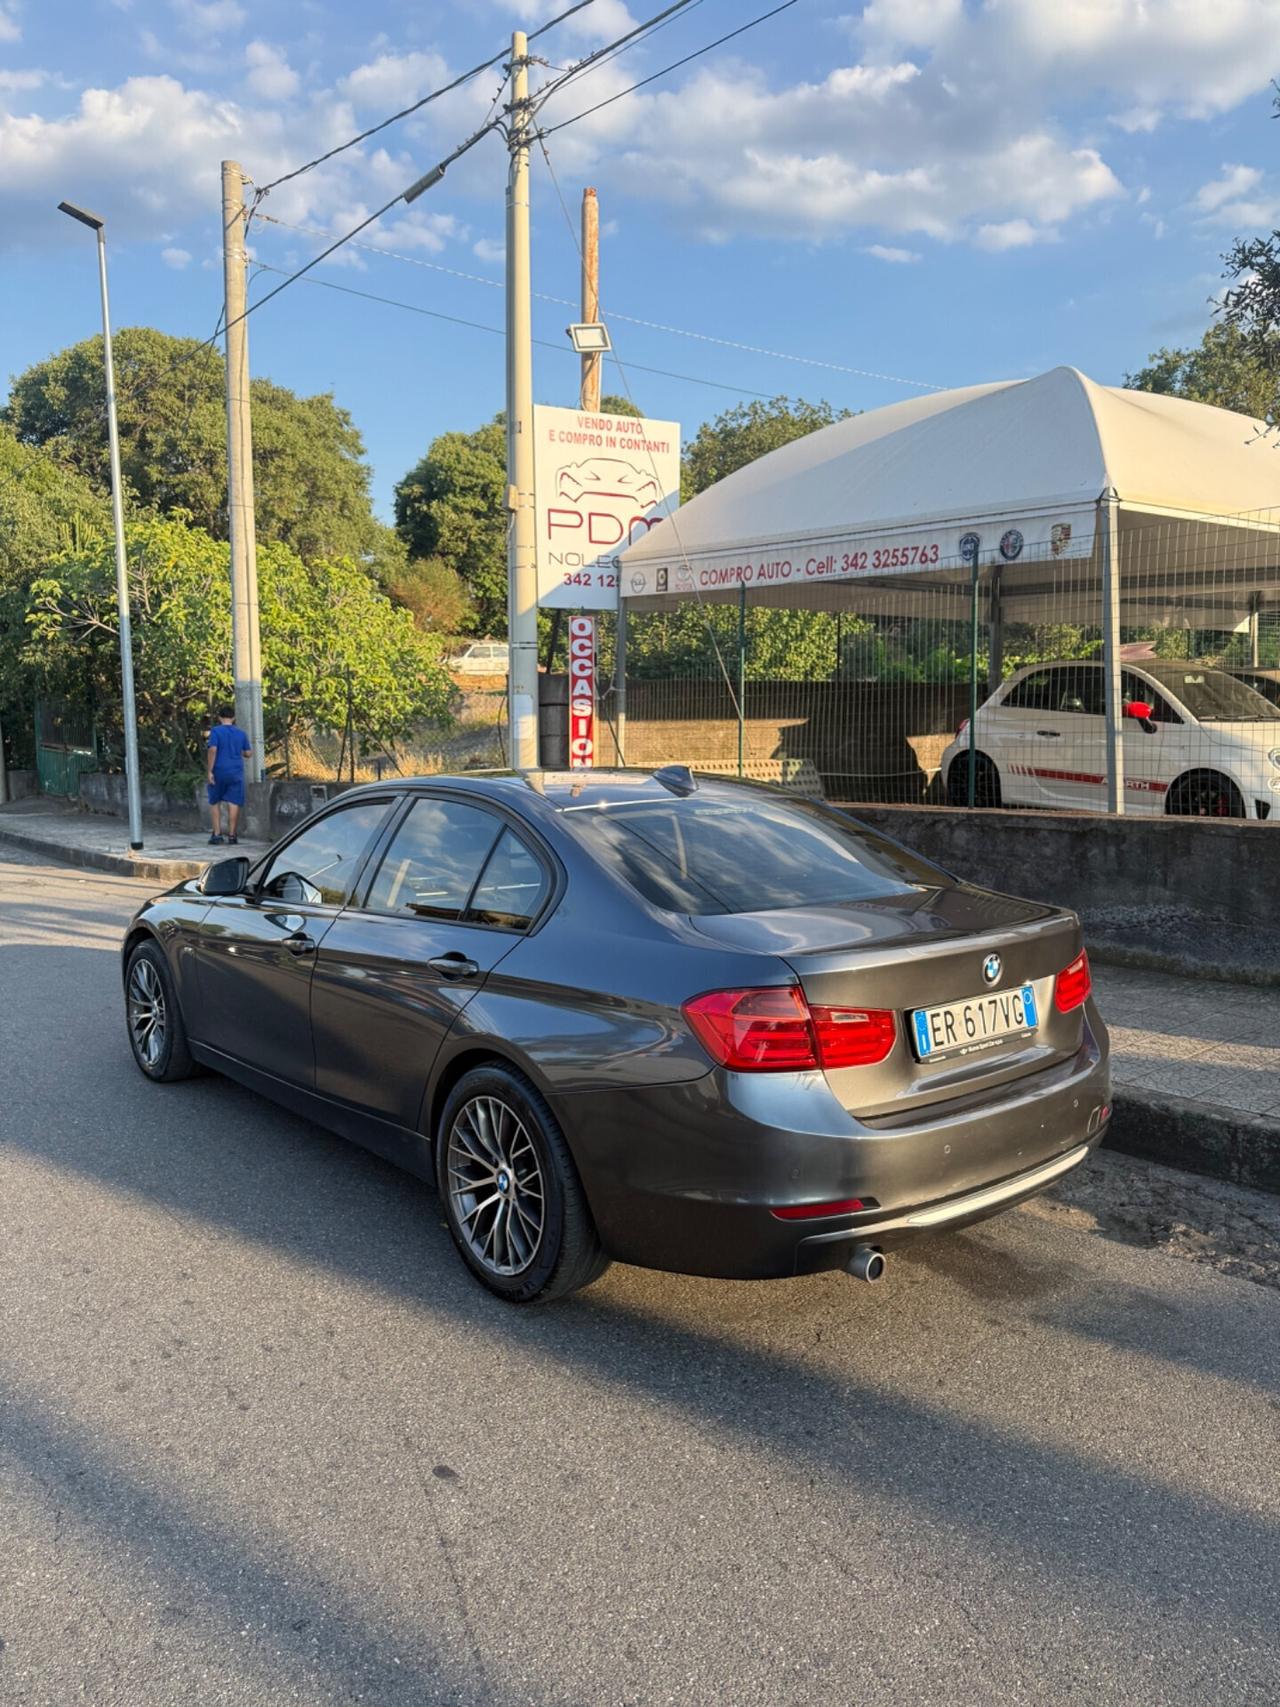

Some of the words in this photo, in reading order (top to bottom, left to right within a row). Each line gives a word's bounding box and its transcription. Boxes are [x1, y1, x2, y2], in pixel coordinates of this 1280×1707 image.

[577, 416, 613, 432] VENDO
[616, 421, 643, 434] AUTO
[549, 429, 555, 442] E
[559, 430, 603, 447] COMPRO
[606, 435, 617, 448] IN
[620, 438, 670, 453] CONTANTI
[700, 564, 753, 586] COMPRO
[757, 560, 792, 580] AUTO
[805, 556, 838, 576] Cell:
[841, 551, 868, 572] 342
[872, 544, 940, 569] 3255763
[564, 573, 592, 587] 342
[930, 1009, 957, 1047] ER
